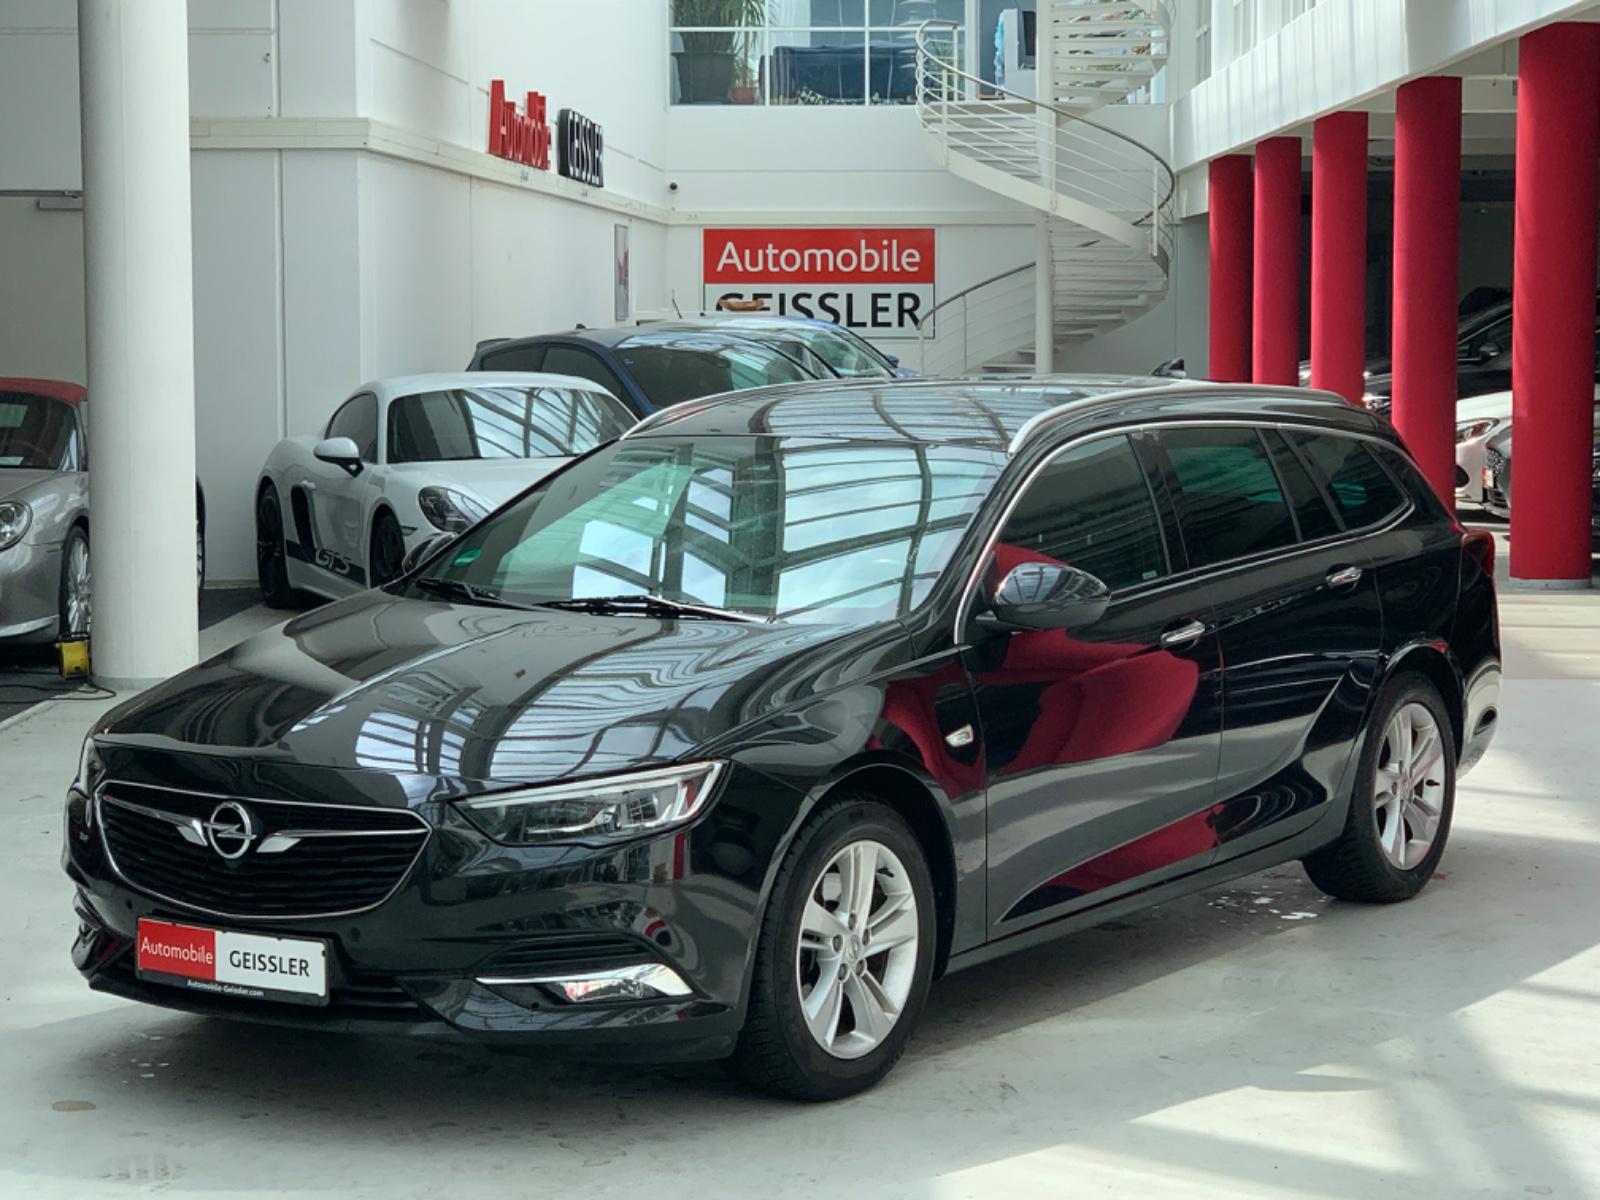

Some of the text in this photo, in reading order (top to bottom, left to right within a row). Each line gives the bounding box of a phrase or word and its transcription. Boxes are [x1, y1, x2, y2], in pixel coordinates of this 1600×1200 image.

[716, 239, 921, 272] Automobile
[140, 936, 310, 977] Automobile GEISSLER
